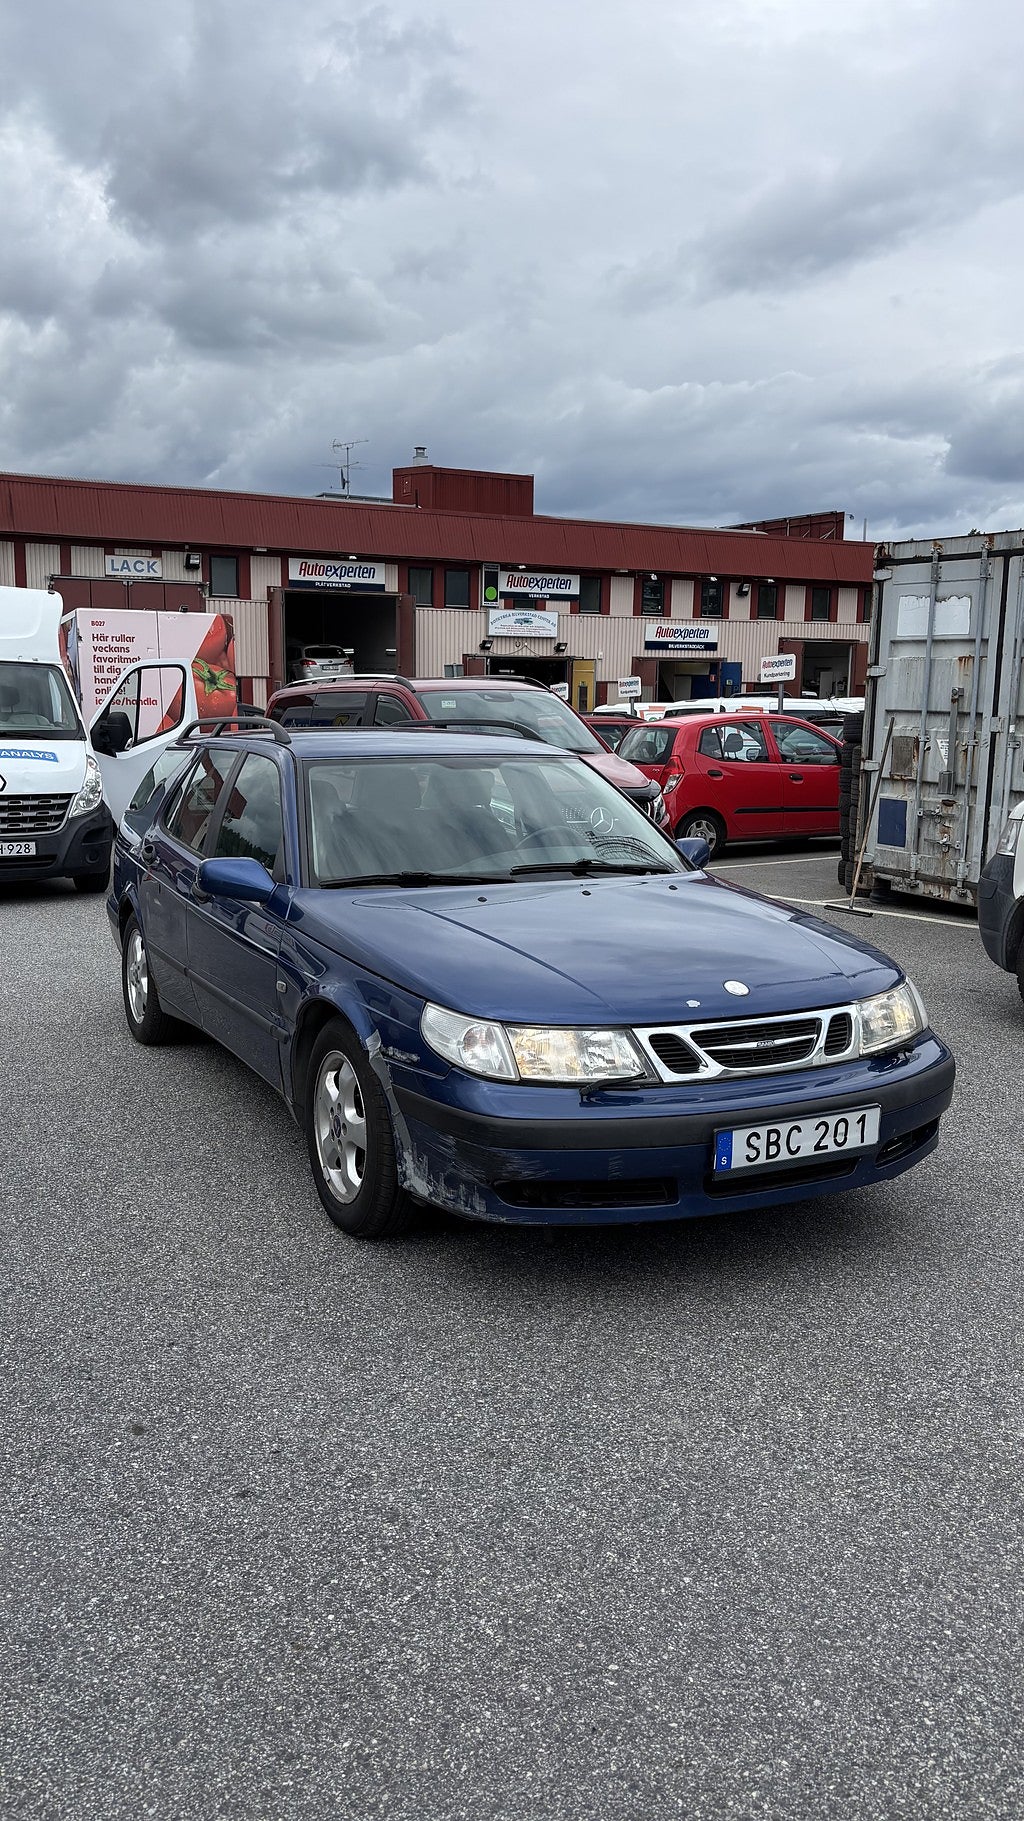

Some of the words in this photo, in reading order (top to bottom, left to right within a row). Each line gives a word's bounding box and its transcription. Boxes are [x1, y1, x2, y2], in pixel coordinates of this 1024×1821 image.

[110, 559, 158, 573] LACK
[298, 561, 376, 580] Autoexperten
[506, 574, 572, 591] Autoexperten
[92, 633, 109, 642] Här
[111, 634, 135, 643] rullar
[655, 626, 709, 640] Autoexperten
[92, 644, 130, 653] veckans
[94, 665, 104, 673] till
[106, 666, 121, 675] dig
[1, 750, 54, 759] ANALYS
[7, 843, 30, 854] 928
[721, 1156, 728, 1165] S
[745, 1125, 802, 1163] SBC
[813, 1113, 867, 1152] 201
